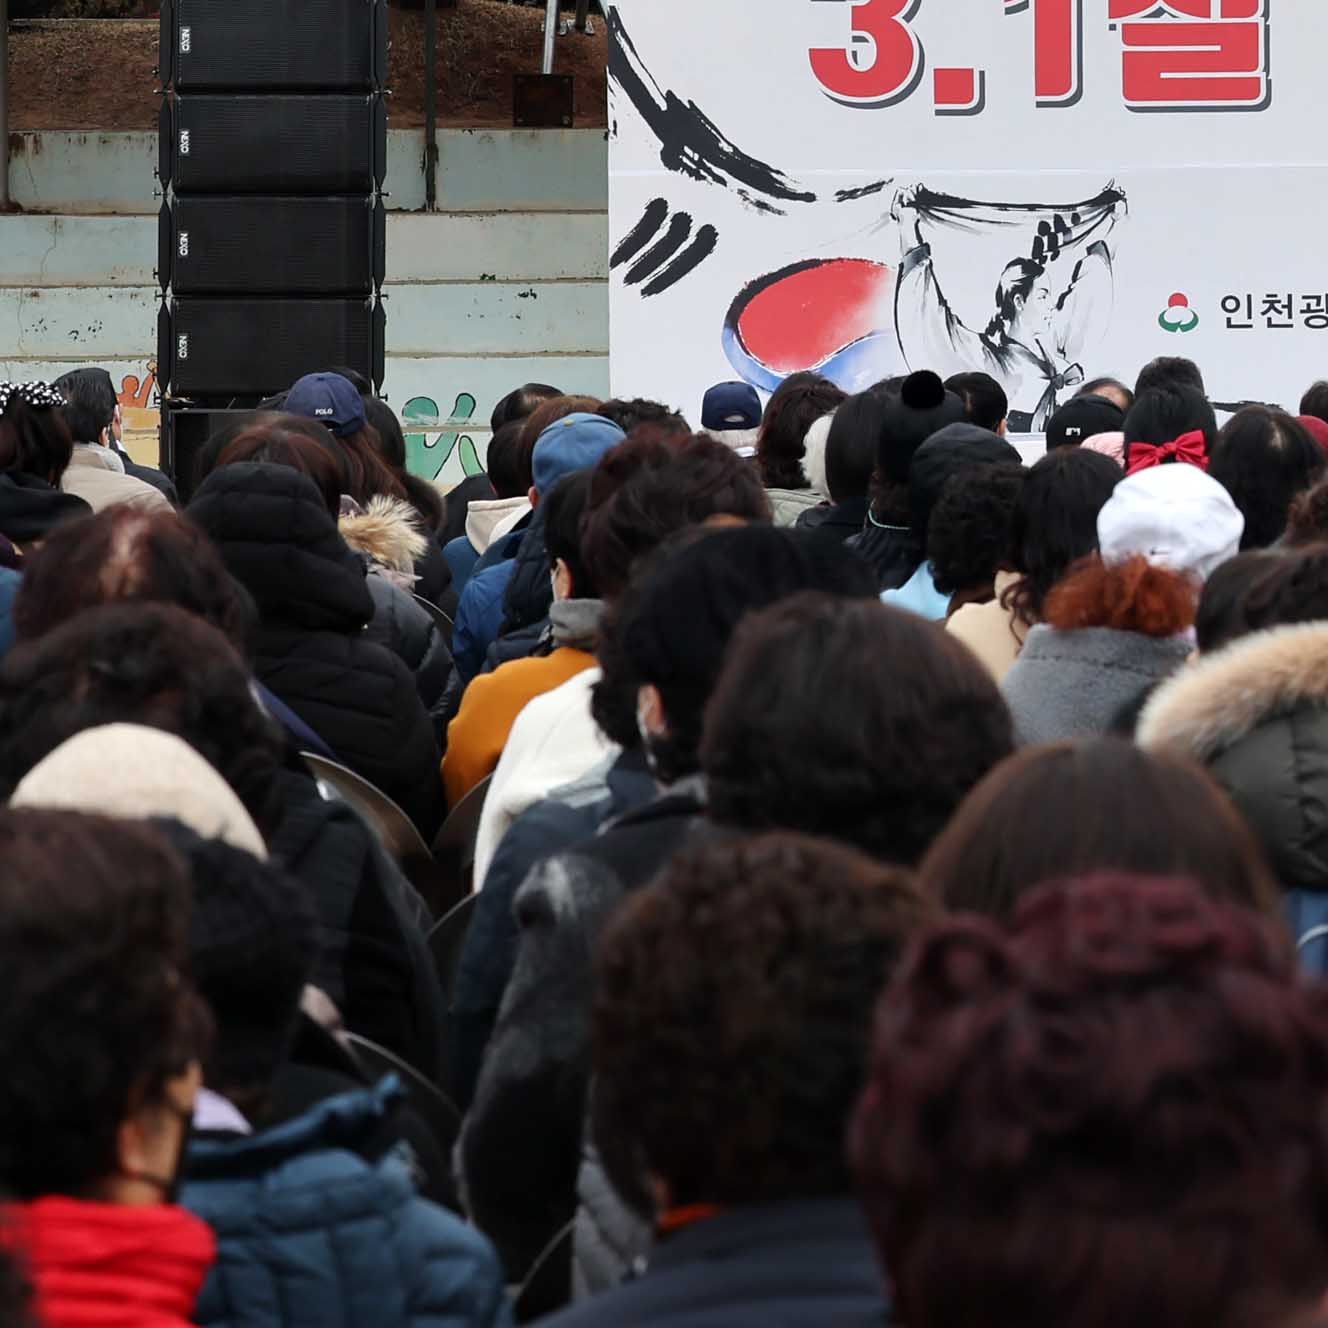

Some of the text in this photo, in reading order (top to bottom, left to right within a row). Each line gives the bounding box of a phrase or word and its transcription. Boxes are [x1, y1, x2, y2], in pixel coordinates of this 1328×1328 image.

[181, 28, 190, 52] NEXO
[180, 130, 189, 153] NEXO
[179, 233, 188, 256] NEXO
[178, 335, 188, 358] NEXO
